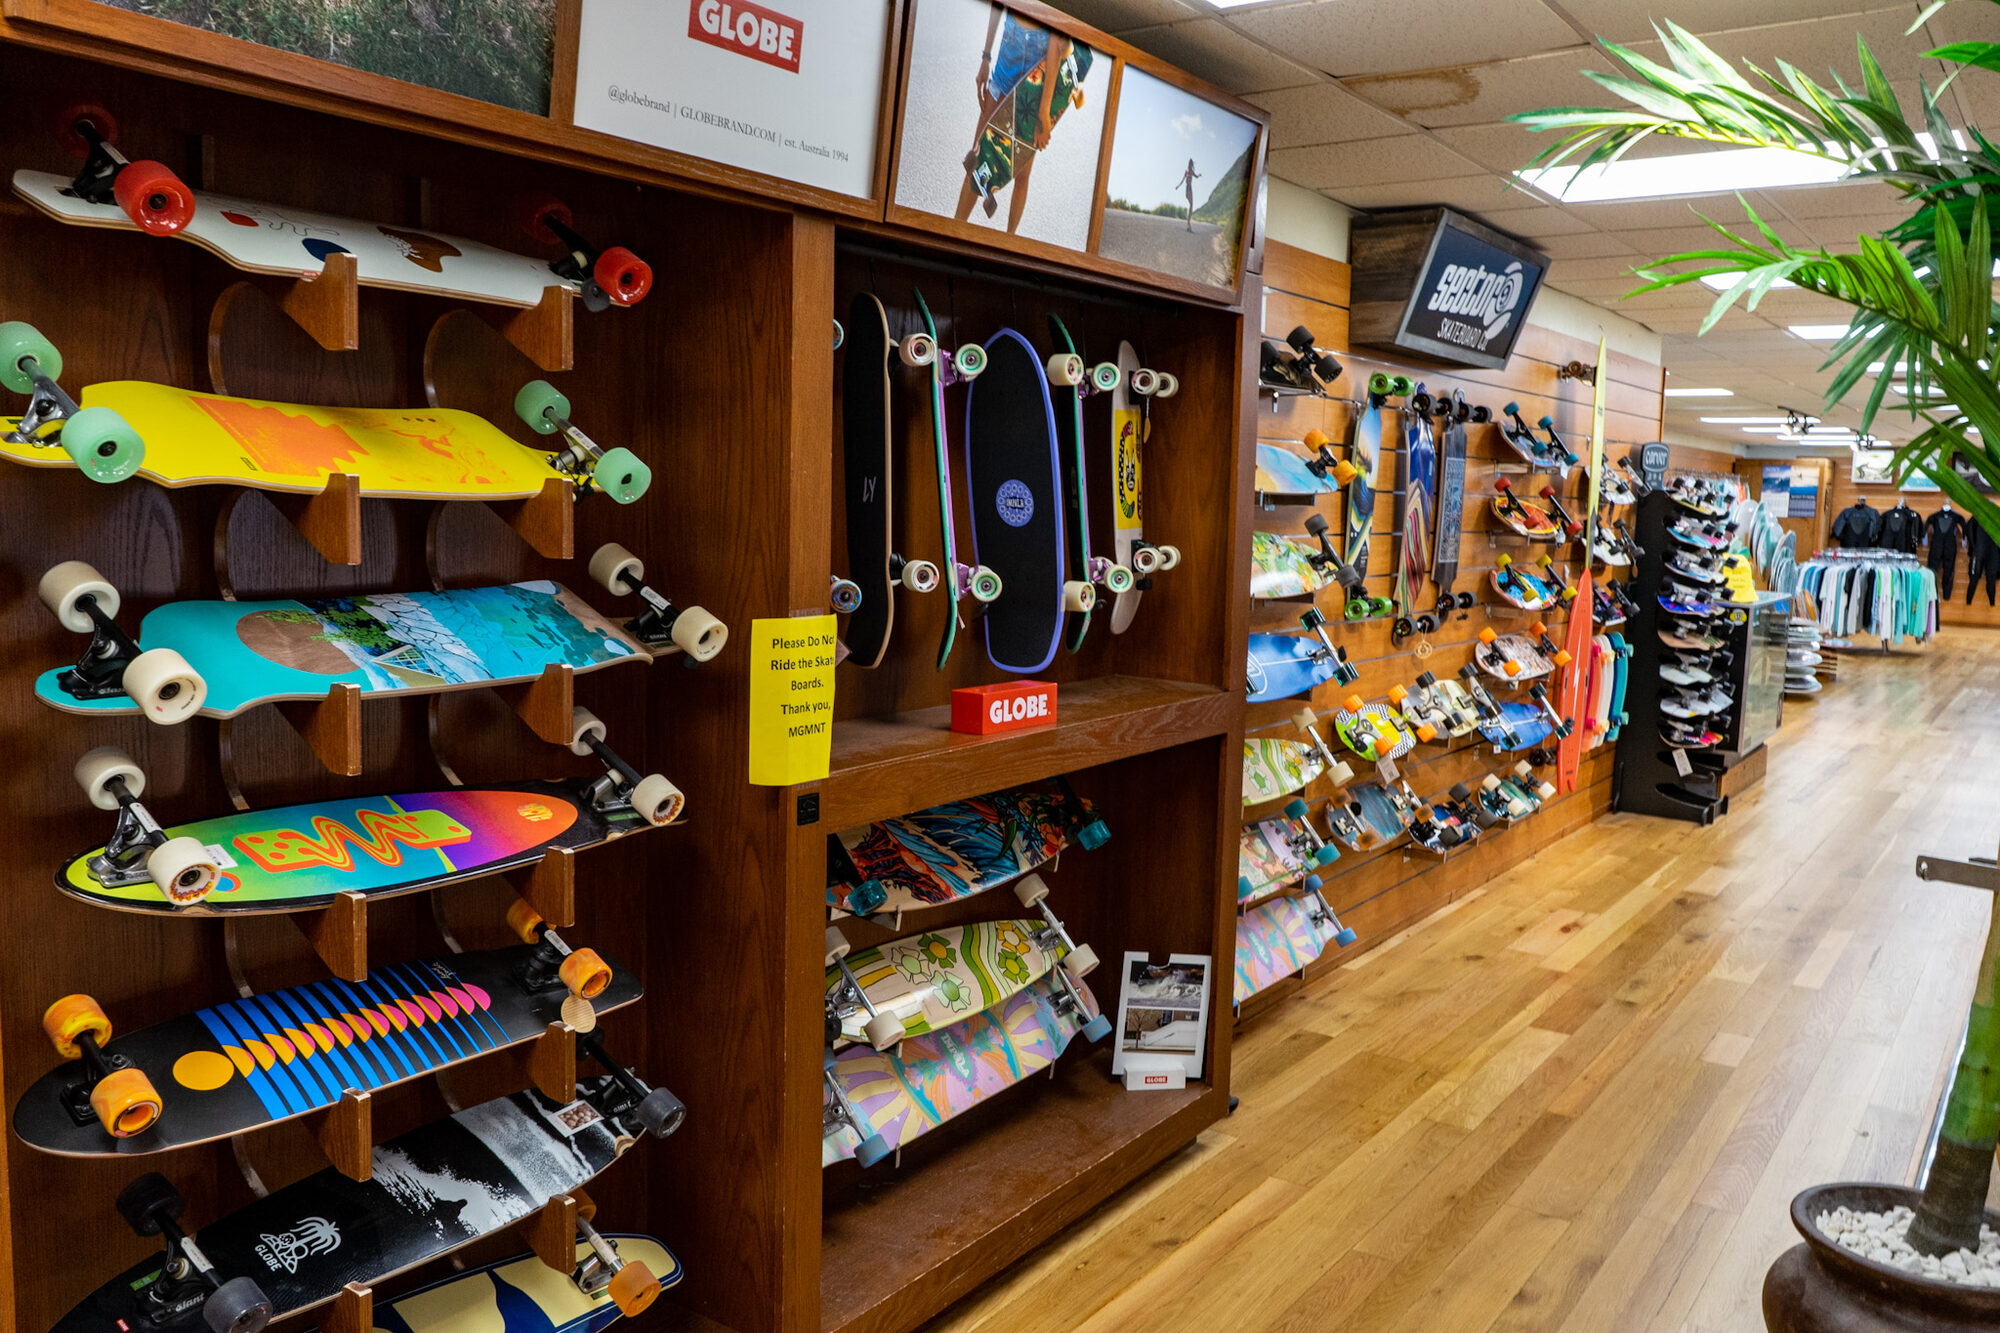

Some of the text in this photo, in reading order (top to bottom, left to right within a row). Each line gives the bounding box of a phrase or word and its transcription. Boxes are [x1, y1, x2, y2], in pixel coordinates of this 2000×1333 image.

[698, 0, 795, 60] GLOBE
[608, 85, 670, 113] @globebrand
[680, 106, 776, 143] GLOBEBRAND.COM
[784, 138, 797, 150] est.
[799, 140, 830, 158] Australia
[832, 149, 849, 162] 1994
[1437, 317, 1481, 348] SKATEBOARD
[772, 637, 806, 649] Please
[808, 636, 820, 646] Do
[771, 659, 796, 670] Ride
[798, 657, 812, 669] the
[791, 677, 824, 691] Boards.
[781, 701, 831, 715] Thank you,
[989, 693, 1048, 724] GLOBE
[788, 722, 826, 738] MGMNT
[254, 1244, 282, 1272] GLOBE
